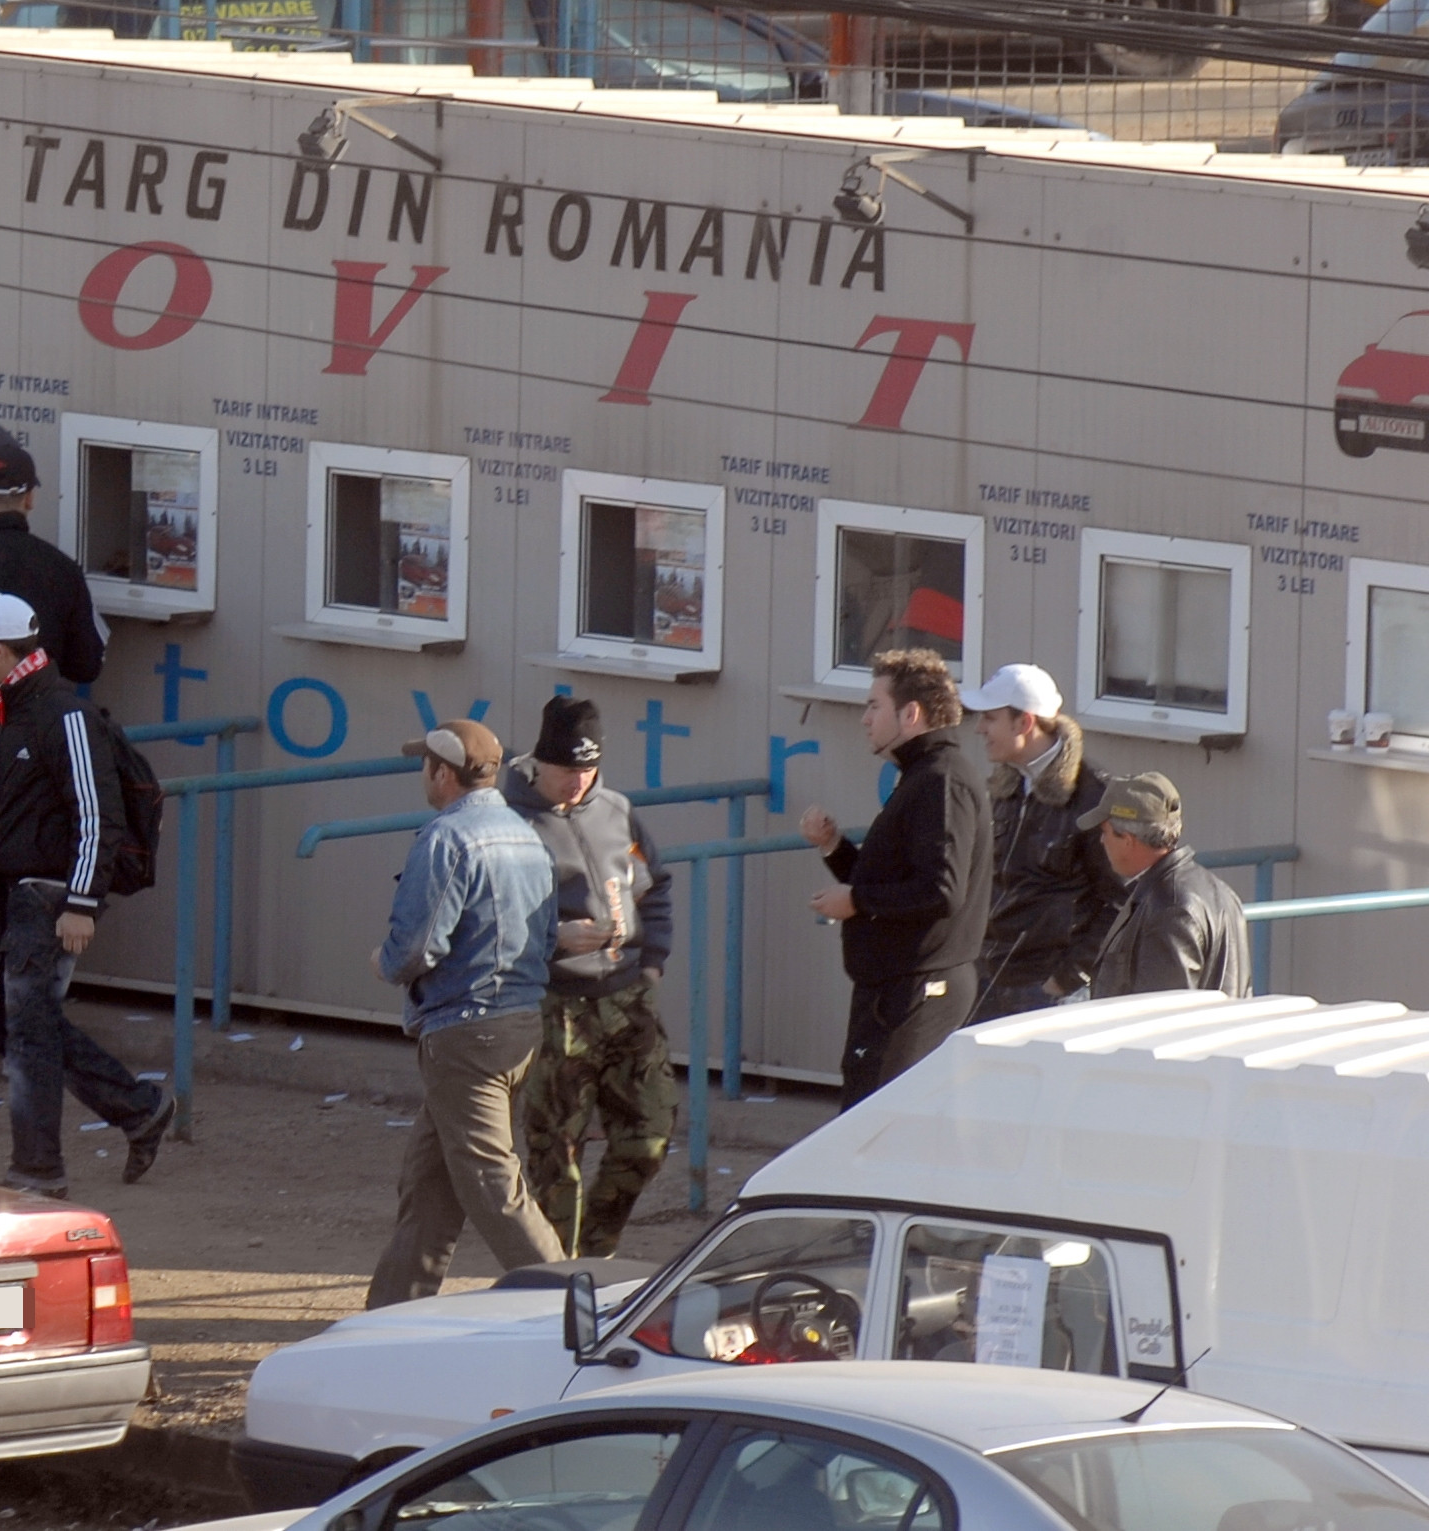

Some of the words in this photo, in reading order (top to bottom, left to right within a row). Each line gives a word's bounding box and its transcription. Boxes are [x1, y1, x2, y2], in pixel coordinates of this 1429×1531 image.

[216, 1, 315, 19] VANZARE
[23, 134, 230, 222] TARG
[281, 160, 434, 245] DIN
[483, 182, 887, 292] ROMANIA
[9, 375, 70, 397] INTRARE
[213, 398, 253, 418] TARIF
[257, 403, 319, 426] INTRARE
[226, 429, 304, 454] VIZITATORI
[464, 427, 504, 447] TARIF
[508, 432, 572, 454] INTRARE
[242, 457, 251, 474] 3
[255, 459, 277, 477] LEI
[477, 457, 557, 483] VIZITATORI
[721, 455, 761, 475] TARIF
[765, 460, 831, 484] INTRARE
[493, 486, 502, 503] 3
[507, 489, 530, 506] LEI
[734, 486, 815, 512] VIZITATORI
[979, 483, 1021, 504] TARIF
[1025, 488, 1091, 512] INTRARE
[750, 516, 759, 533] 3
[764, 518, 787, 536] LEI
[993, 515, 1076, 542] VIZITATORI
[1247, 513, 1290, 534] TARIF
[1009, 544, 1019, 561] 3
[1023, 546, 1047, 565] LEI
[1261, 545, 1344, 572] VIZITATORI
[1277, 575, 1287, 592] 3
[1290, 577, 1315, 595] LEI
